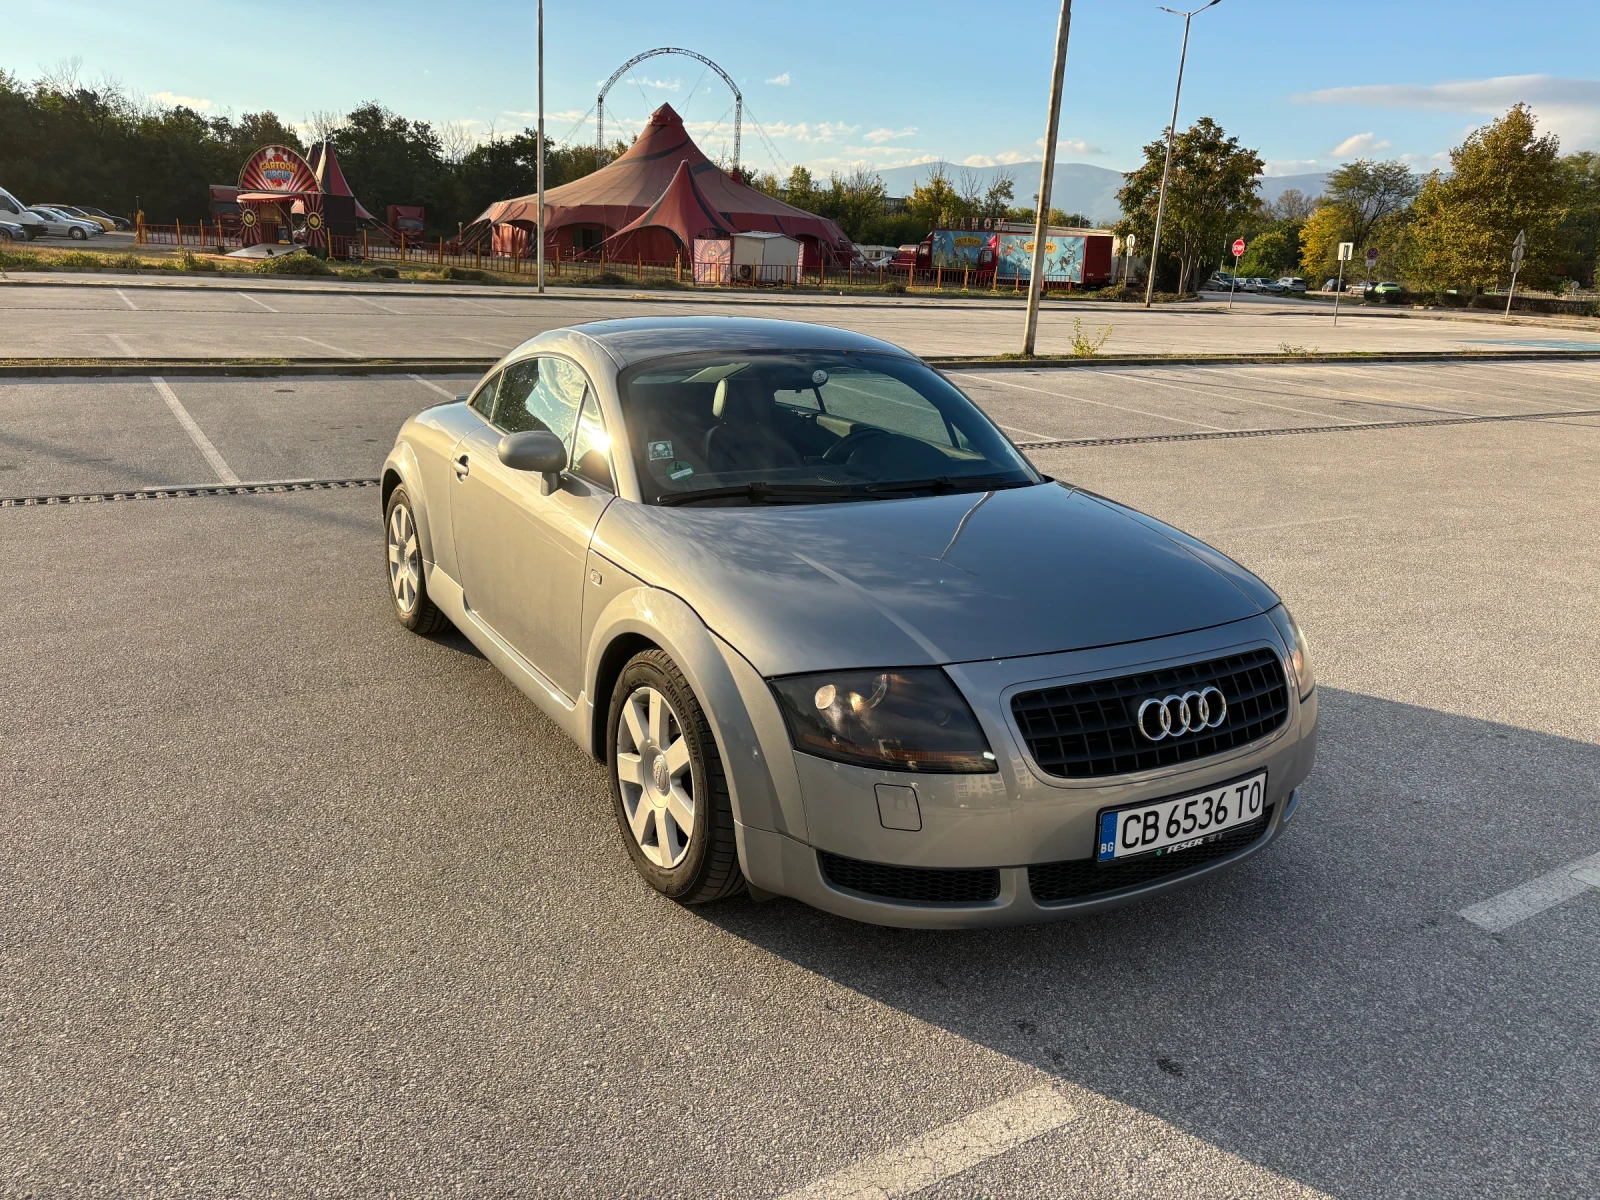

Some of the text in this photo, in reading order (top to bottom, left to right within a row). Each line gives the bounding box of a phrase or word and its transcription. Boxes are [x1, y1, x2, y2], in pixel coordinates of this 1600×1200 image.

[260, 161, 298, 173] CARTOON
[265, 170, 292, 179] CIRCUS
[665, 680, 701, 764] BRIDGESTONE
[1121, 780, 1261, 849] CB 6536 TO
[1100, 842, 1114, 854] BG
[1167, 838, 1204, 854] FESER
